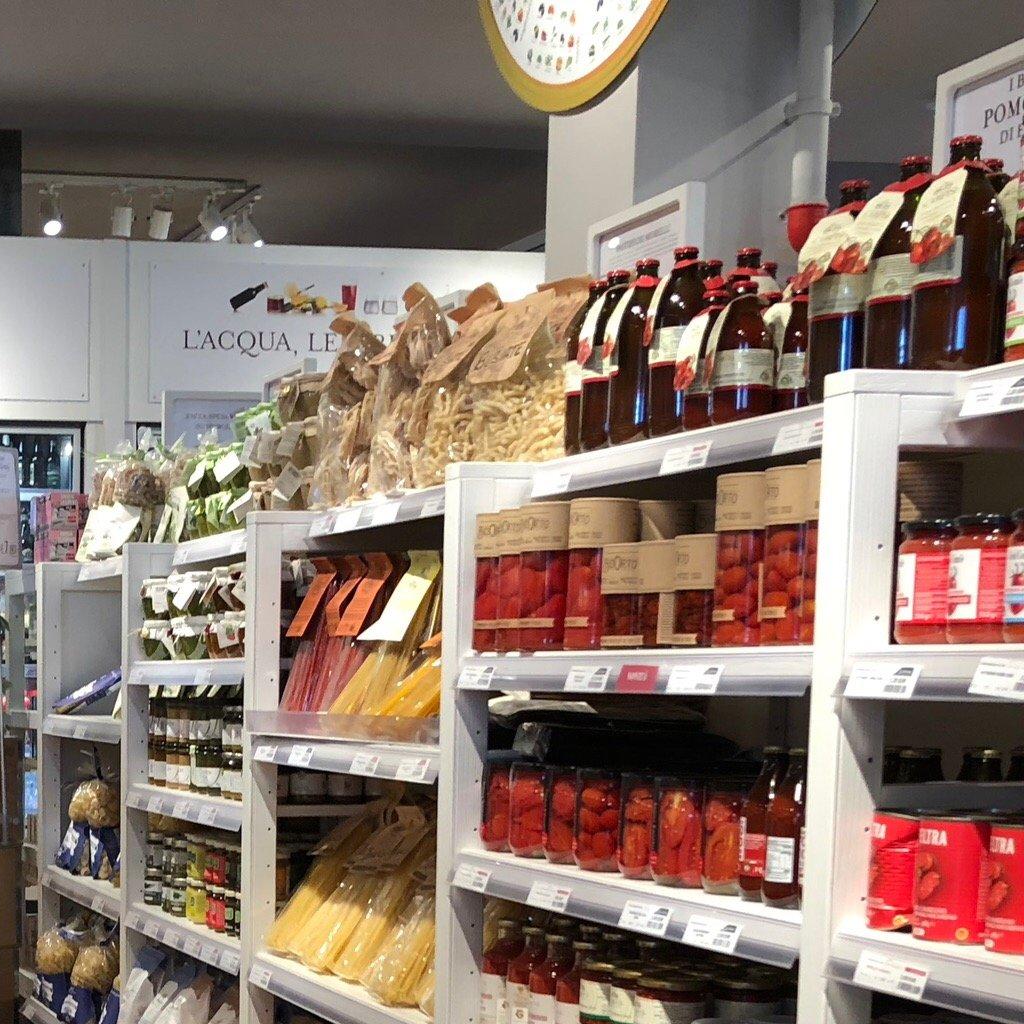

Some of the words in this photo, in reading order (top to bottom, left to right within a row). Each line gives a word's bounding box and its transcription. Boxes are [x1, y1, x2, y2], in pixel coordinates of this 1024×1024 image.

[983, 96, 1024, 129] POM
[183, 329, 298, 357] L'ACQUA,
[309, 332, 338, 352] LE
